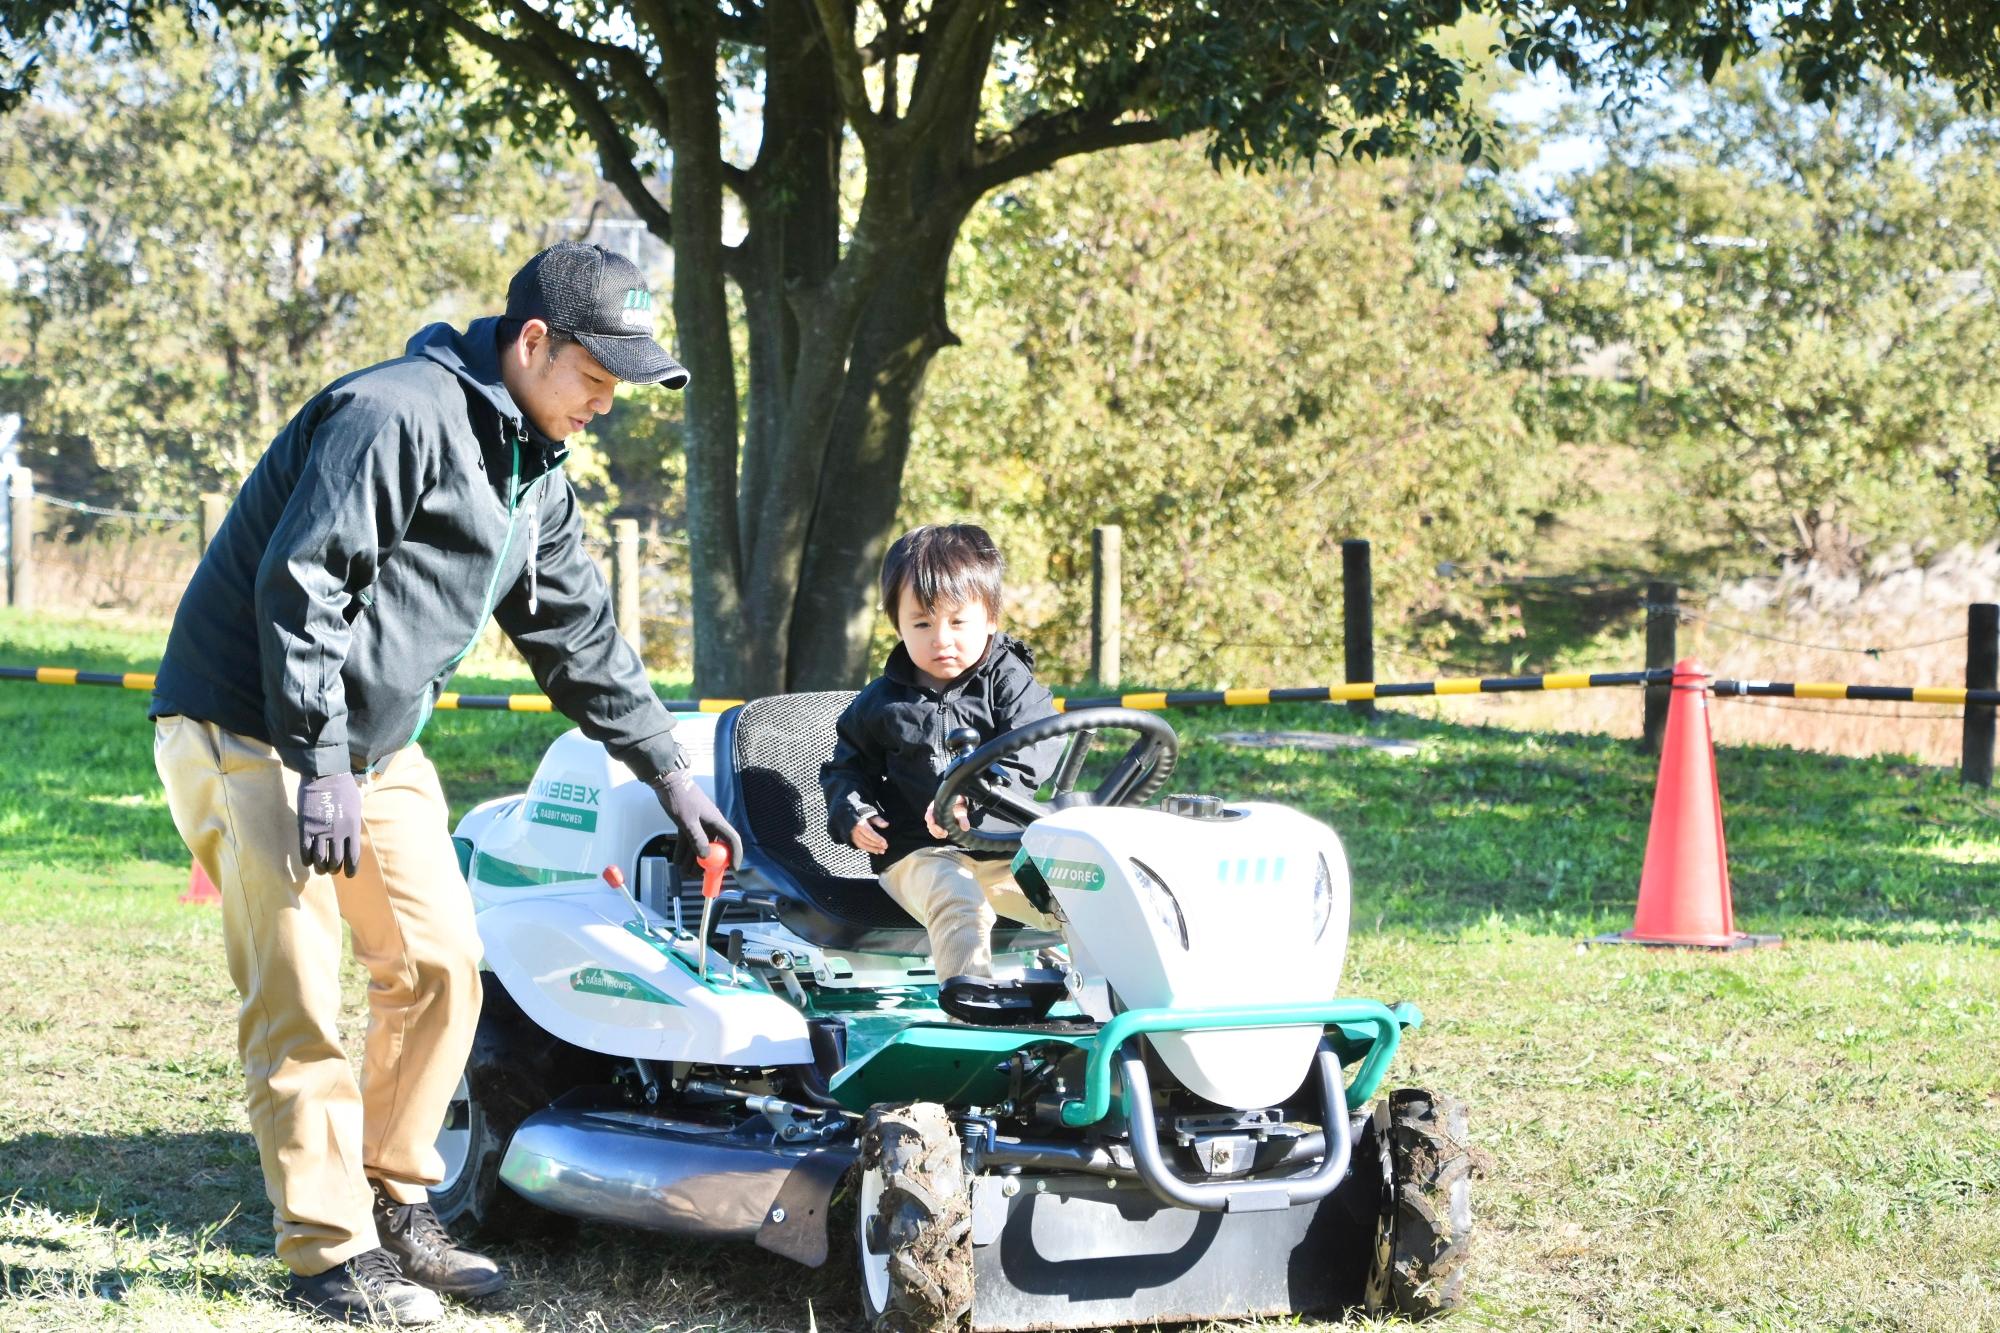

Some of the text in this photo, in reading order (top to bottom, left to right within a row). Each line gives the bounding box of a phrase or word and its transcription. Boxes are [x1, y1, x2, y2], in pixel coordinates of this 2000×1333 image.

[540, 808, 583, 825] RABBIT MOWER
[1070, 869, 1100, 884] OREC
